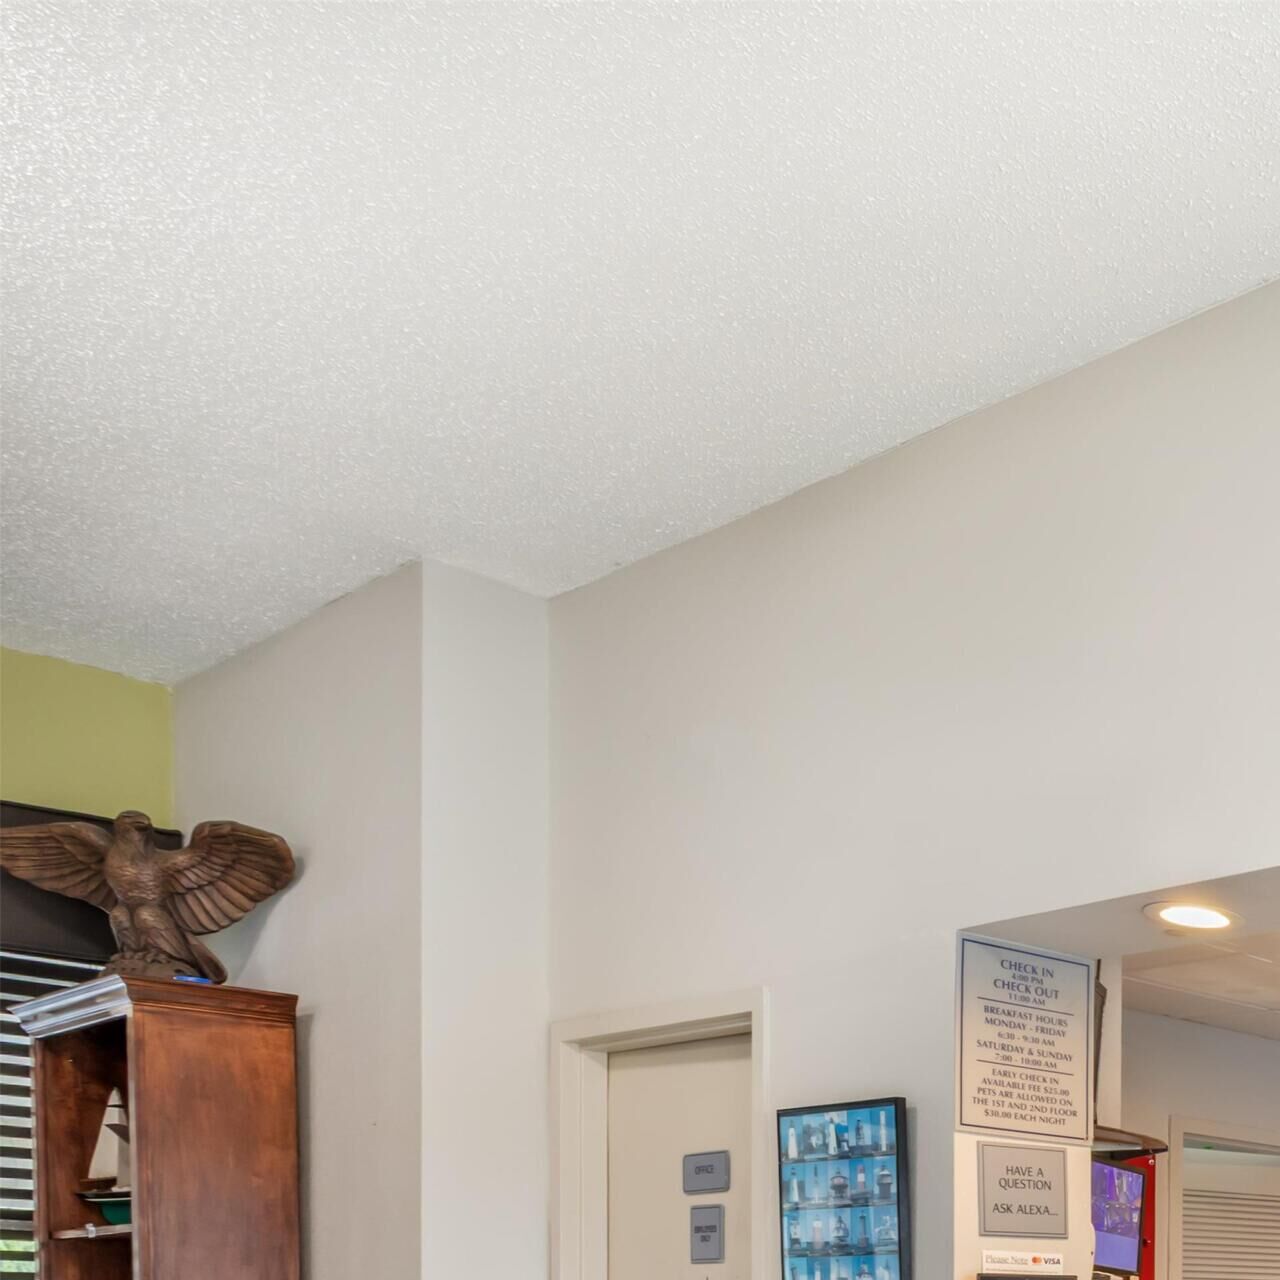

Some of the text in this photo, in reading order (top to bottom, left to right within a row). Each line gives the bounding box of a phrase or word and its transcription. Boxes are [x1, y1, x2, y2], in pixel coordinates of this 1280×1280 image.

[1000, 959, 1054, 978] CHECK IN
[1031, 977, 1044, 985] PM
[994, 978, 1059, 1000] CHECK OUT
[1009, 993, 1045, 1006] 11:00 AM
[984, 1006, 1068, 1027] BREAKFAST HOURS
[985, 1017, 1027, 1031] MONDAY
[1035, 1025, 1066, 1037] FRIDAY
[976, 1040, 1025, 1055] SATURDAY
[1037, 1049, 1072, 1062] SUNDAY
[992, 1070, 1017, 1079] EARLY
[1019, 1073, 1048, 1083] CHECK
[982, 1078, 1025, 1090] AVAILABLE
[1028, 1084, 1041, 1092] FEE
[977, 1088, 1073, 1106] PETS ARE ALLOWED ON
[973, 1097, 1078, 1116] THE 1ST AND 2ND FLOOR
[1014, 1113, 1037, 1122] EACH
[1039, 1116, 1066, 1125] NIGHT
[1006, 1166, 1044, 1178] HAVE A
[999, 1178, 1051, 1190] QUESTION
[992, 1203, 1013, 1213] ASK
